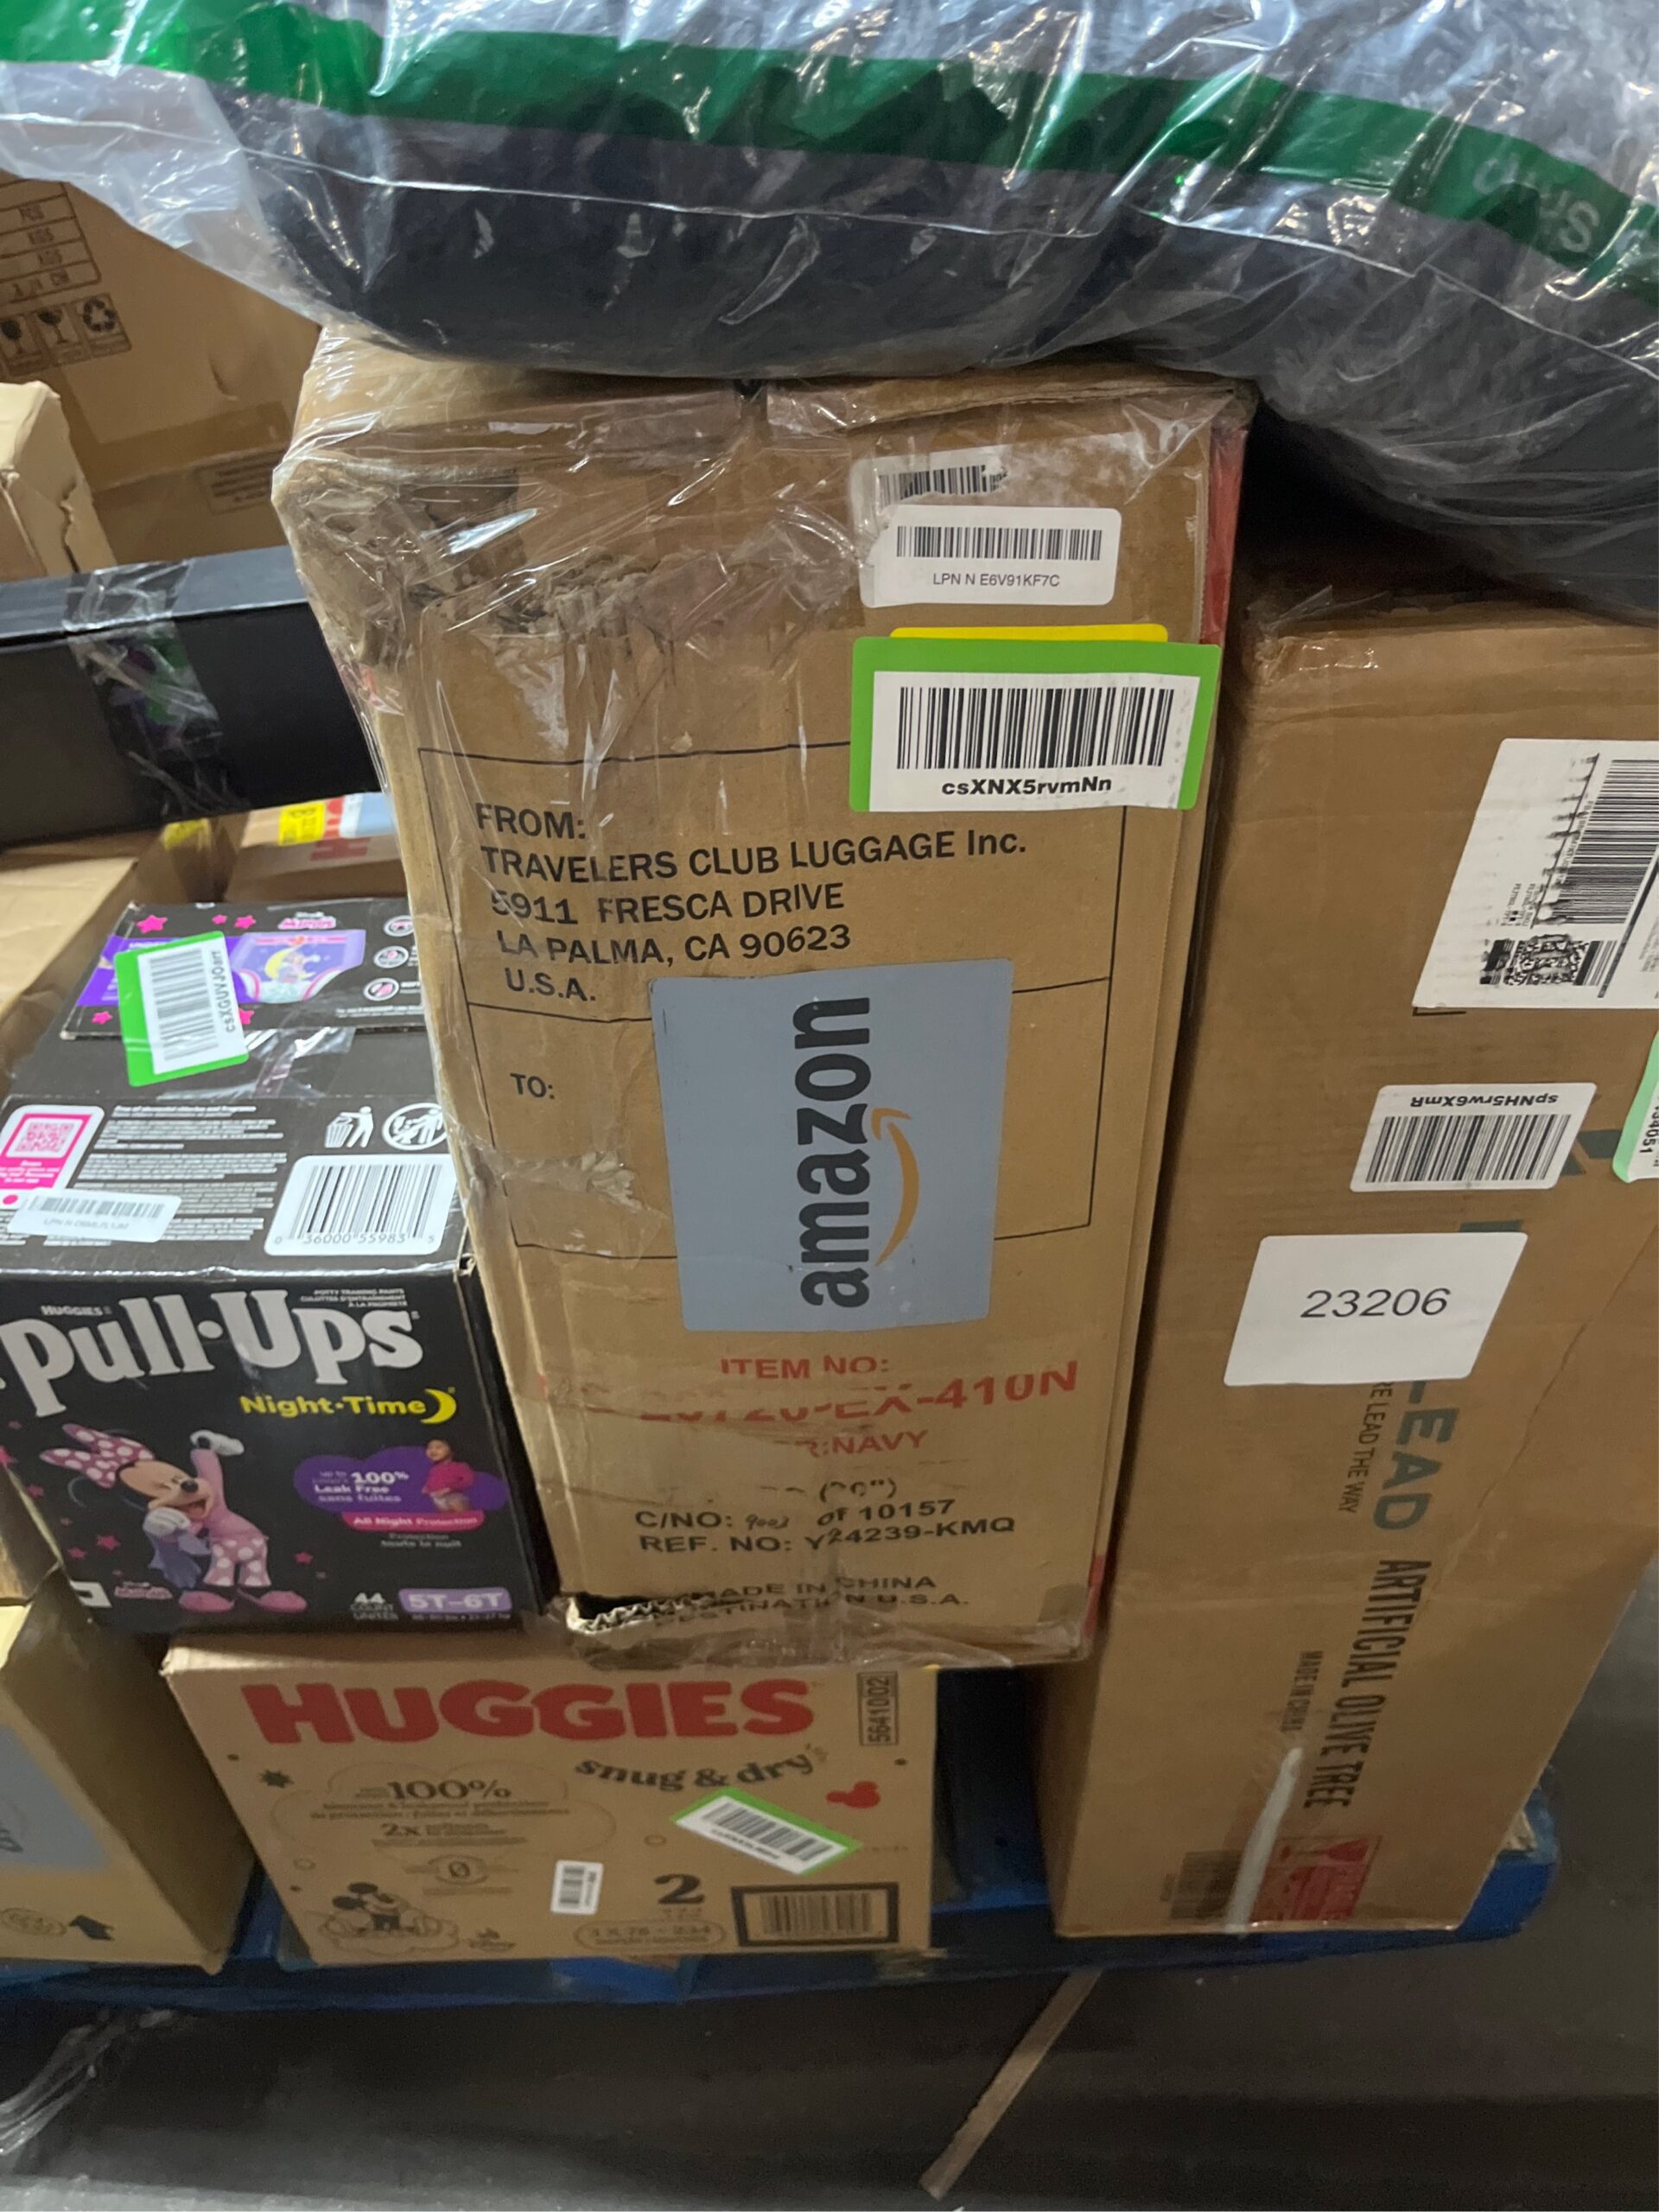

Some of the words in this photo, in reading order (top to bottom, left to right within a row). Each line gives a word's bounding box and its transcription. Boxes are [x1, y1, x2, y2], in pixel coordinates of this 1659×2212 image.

[932, 572, 961, 586] LPN
[965, 573, 976, 586] N
[979, 573, 1060, 588] E6V91KF7C
[941, 776, 1112, 795] csXNX5rvmNn
[476, 804, 587, 840] FROM:
[480, 846, 677, 883] TRAVELERS
[689, 846, 779, 876] CLUB
[791, 830, 955, 868] LUGGAGE
[968, 829, 1027, 857] Inc.
[491, 890, 578, 925] 5911
[598, 891, 733, 925] FRESCA
[743, 882, 844, 918] DRIVE
[497, 929, 538, 959] LA
[545, 935, 673, 967] PALMA,
[684, 933, 730, 961] CA
[740, 923, 851, 958] 90623
[505, 967, 596, 1002] U.S.A.
[510, 1071, 555, 1100] TO:
[1409, 1093, 1559, 1111] spNH5rw6XmR
[792, 996, 872, 1308] amazon
[1300, 1287, 1452, 1319] 23206
[721, 1357, 810, 1380] ITEM
[824, 1355, 888, 1375] NO:
[1358, 1402, 1389, 1445] LEAD
[351, 1471, 410, 1485] 100%
[1347, 1446, 1376, 1479] THE
[859, 1498, 956, 1522] 10157
[1338, 1481, 1365, 1514] WAY
[635, 1510, 733, 1529] C/NO:
[639, 1535, 718, 1553] REF.
[729, 1535, 791, 1553] NO:
[1341, 1559, 1433, 1688] ARTIFICIAL
[240, 1678, 815, 1745] HUGGIES
[1320, 1694, 1387, 1758] OLIVE
[575, 1758, 687, 1792] snug
[694, 1767, 729, 1788] &
[735, 1752, 815, 1785] dry
[1302, 1760, 1365, 1809] TREE
[386, 1779, 512, 1801] 100%
[653, 1872, 705, 1905] 2
